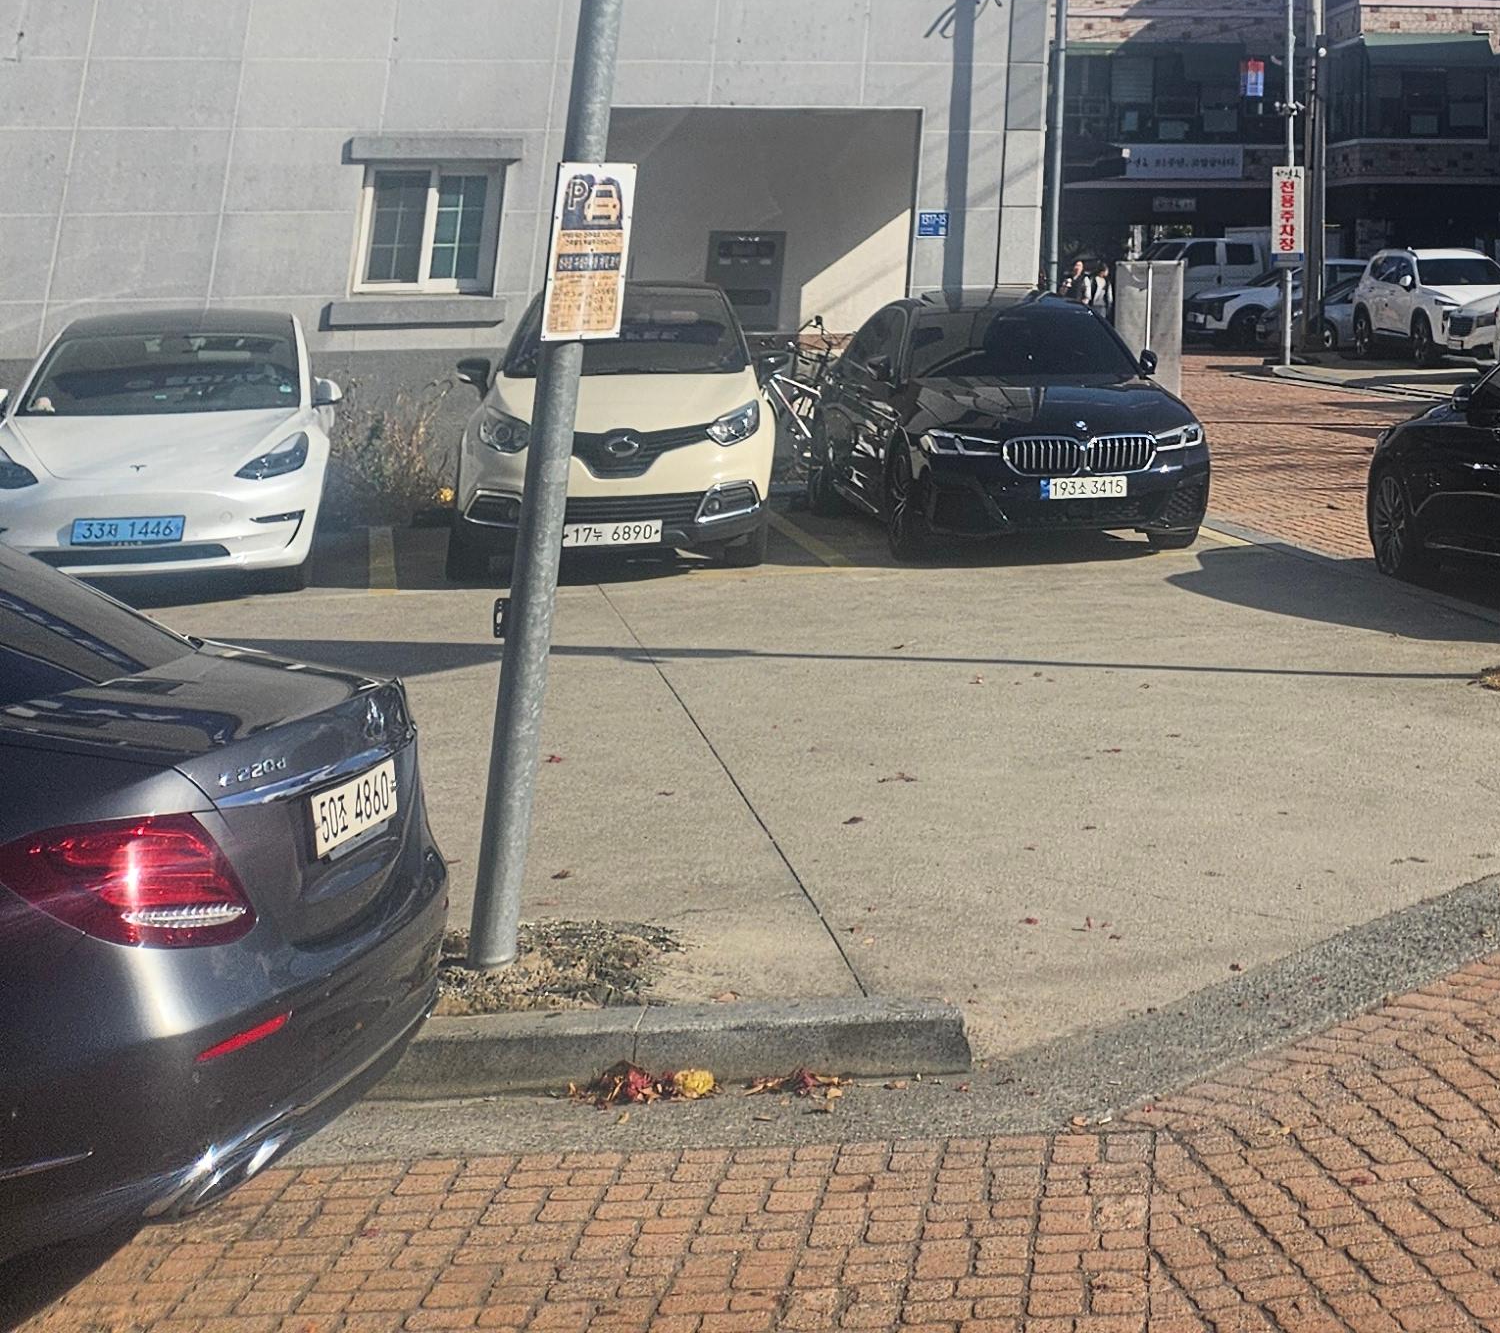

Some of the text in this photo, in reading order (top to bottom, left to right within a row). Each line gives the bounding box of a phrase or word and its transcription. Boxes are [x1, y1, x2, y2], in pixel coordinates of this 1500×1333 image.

[1279, 180, 1296, 251] 전용주차장
[1052, 479, 1123, 496] 193소 3415
[129, 520, 173, 539] 1446
[611, 524, 653, 542] 6890
[319, 770, 389, 844] 50조 4860
